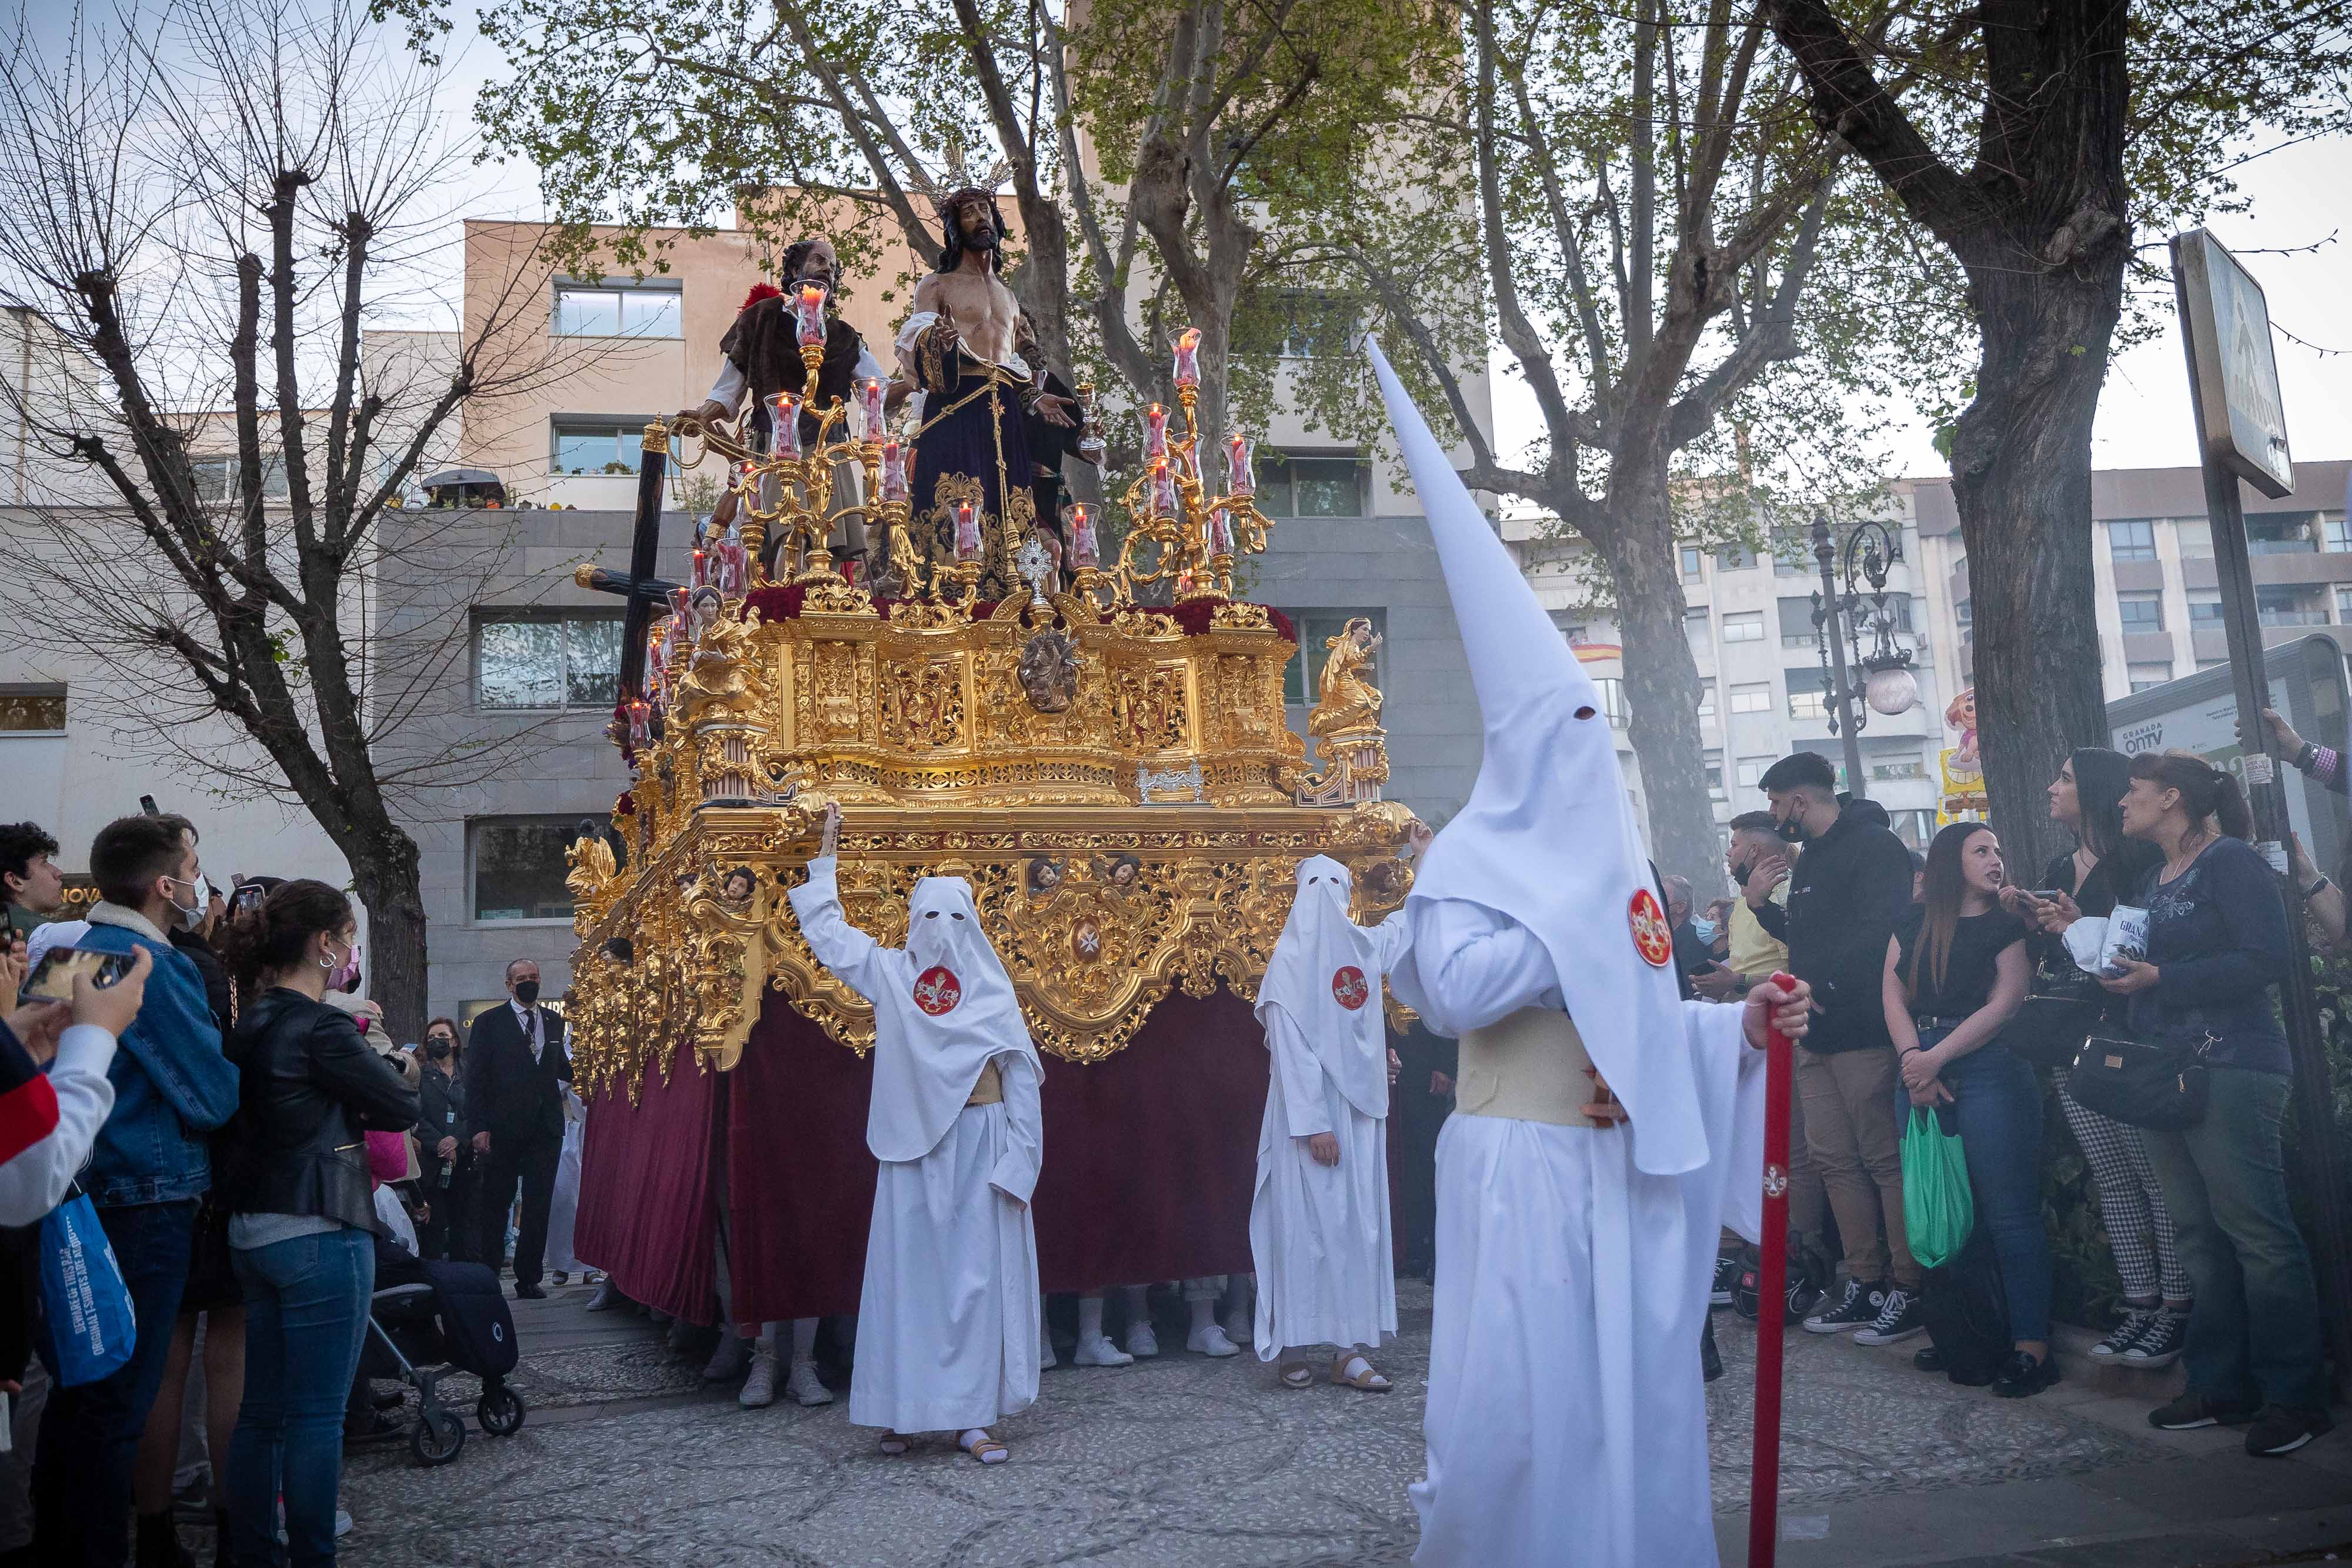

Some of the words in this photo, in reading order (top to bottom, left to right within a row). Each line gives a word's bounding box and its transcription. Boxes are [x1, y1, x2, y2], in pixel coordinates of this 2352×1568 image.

[2123, 723, 2162, 739] GRANADA
[62, 1265, 76, 1288] THIS
[75, 1258, 88, 1278] ARE
[66, 1288, 78, 1299] OF
[78, 1276, 96, 1316] T-SHIRTS
[68, 1298, 86, 1335] BEWARE
[88, 1313, 105, 1356] ORIGINAL
